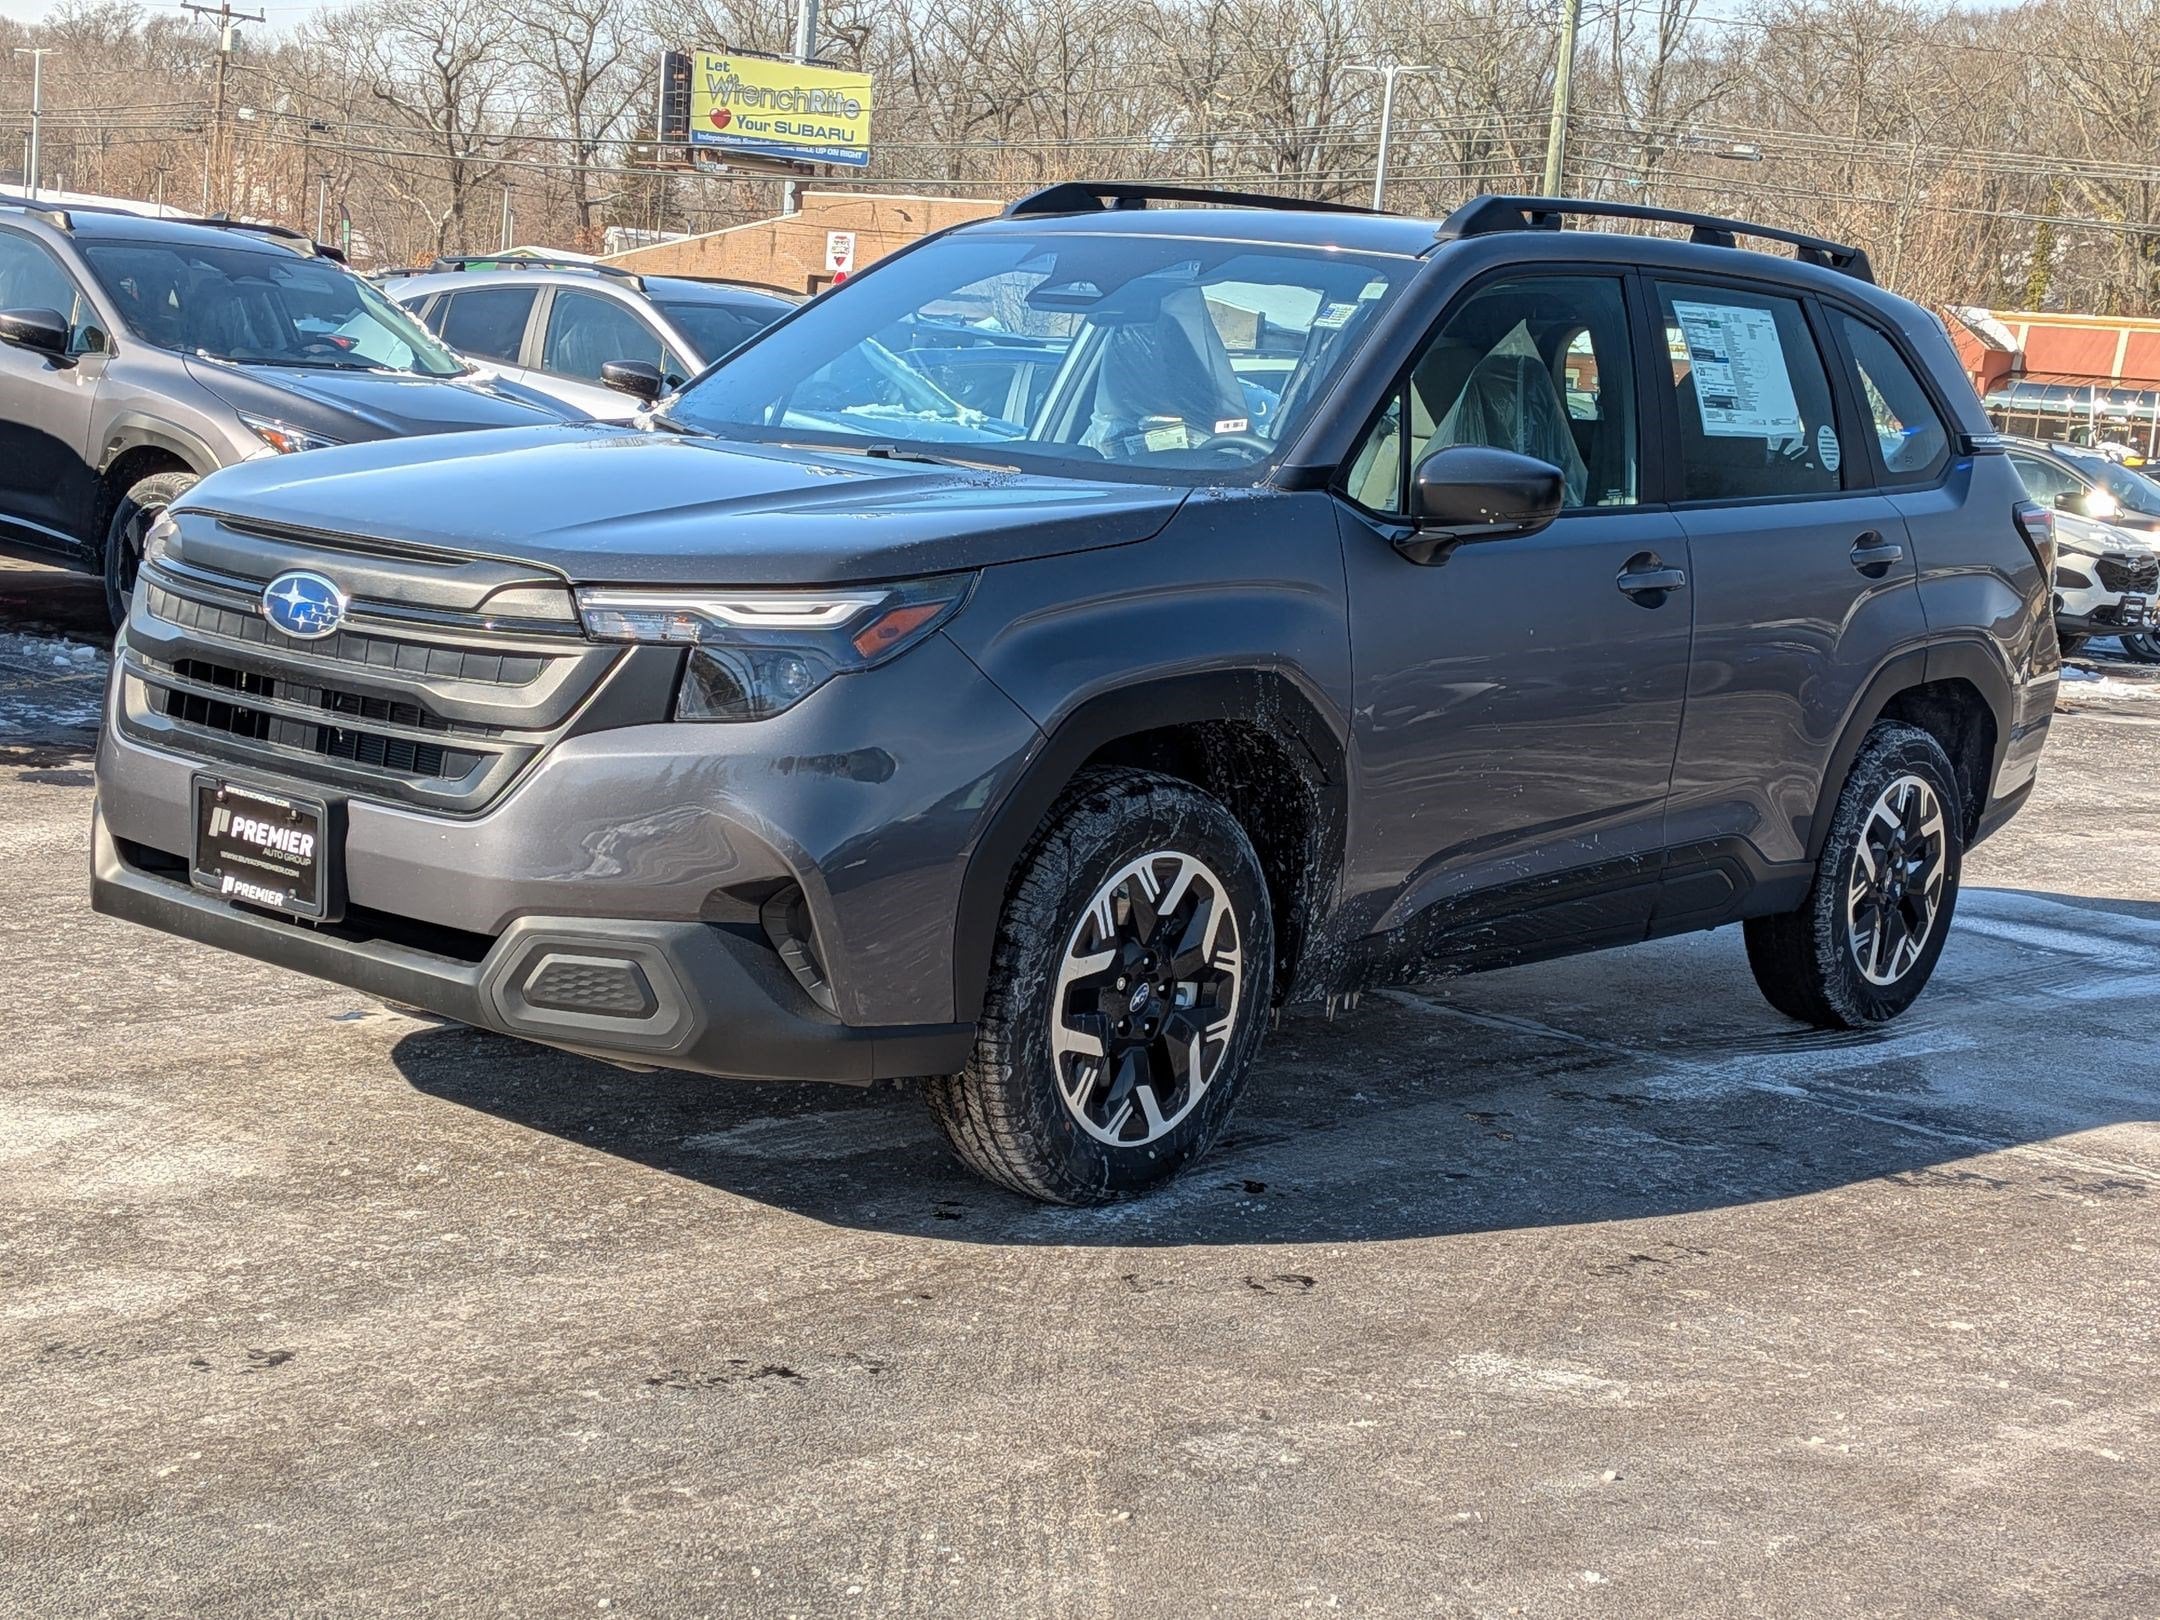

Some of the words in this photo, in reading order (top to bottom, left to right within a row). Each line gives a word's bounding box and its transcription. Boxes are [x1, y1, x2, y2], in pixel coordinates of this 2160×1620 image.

[706, 57, 730, 72] Let
[706, 73, 861, 119] WrenchRite
[736, 115, 771, 133] Your
[774, 121, 855, 142] SUBARU
[815, 147, 826, 155] UP
[827, 148, 839, 156] ON
[840, 149, 862, 160] RIGHT
[230, 816, 314, 857] PREMIER
[262, 847, 283, 860] AUTO
[284, 853, 312, 866] GROUP
[234, 881, 284, 907] PREMIER
